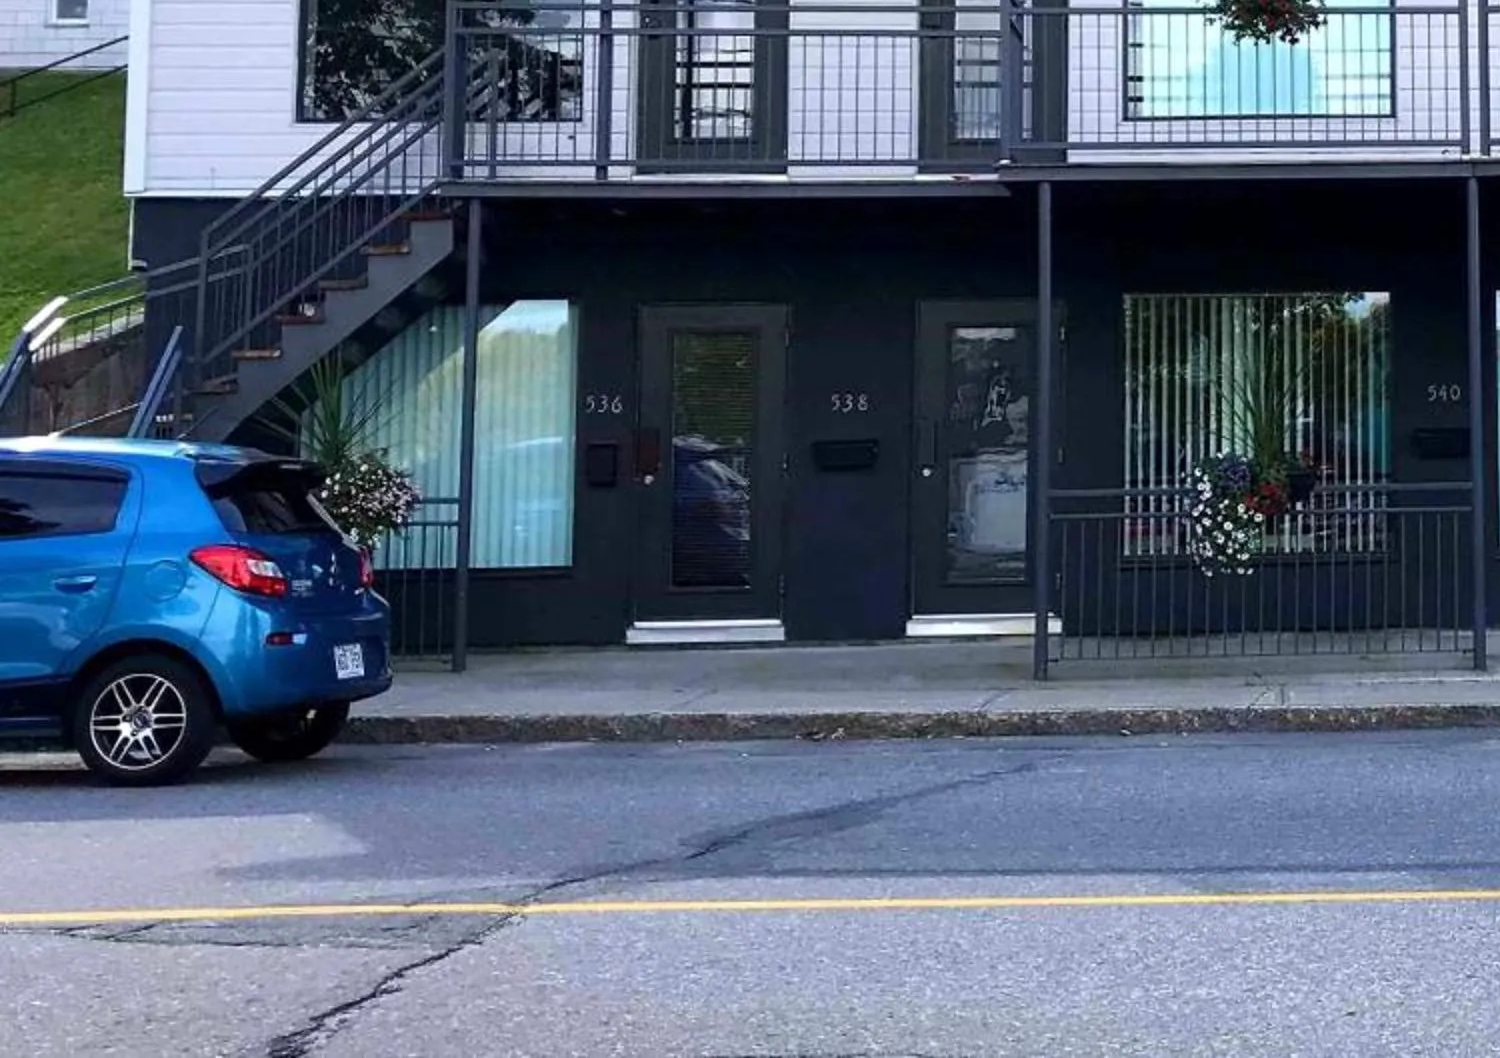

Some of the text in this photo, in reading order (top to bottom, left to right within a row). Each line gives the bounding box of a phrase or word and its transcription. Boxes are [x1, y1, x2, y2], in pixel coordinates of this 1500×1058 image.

[1427, 384, 1461, 401] 540
[585, 394, 623, 414] 536
[831, 393, 869, 413] 538
